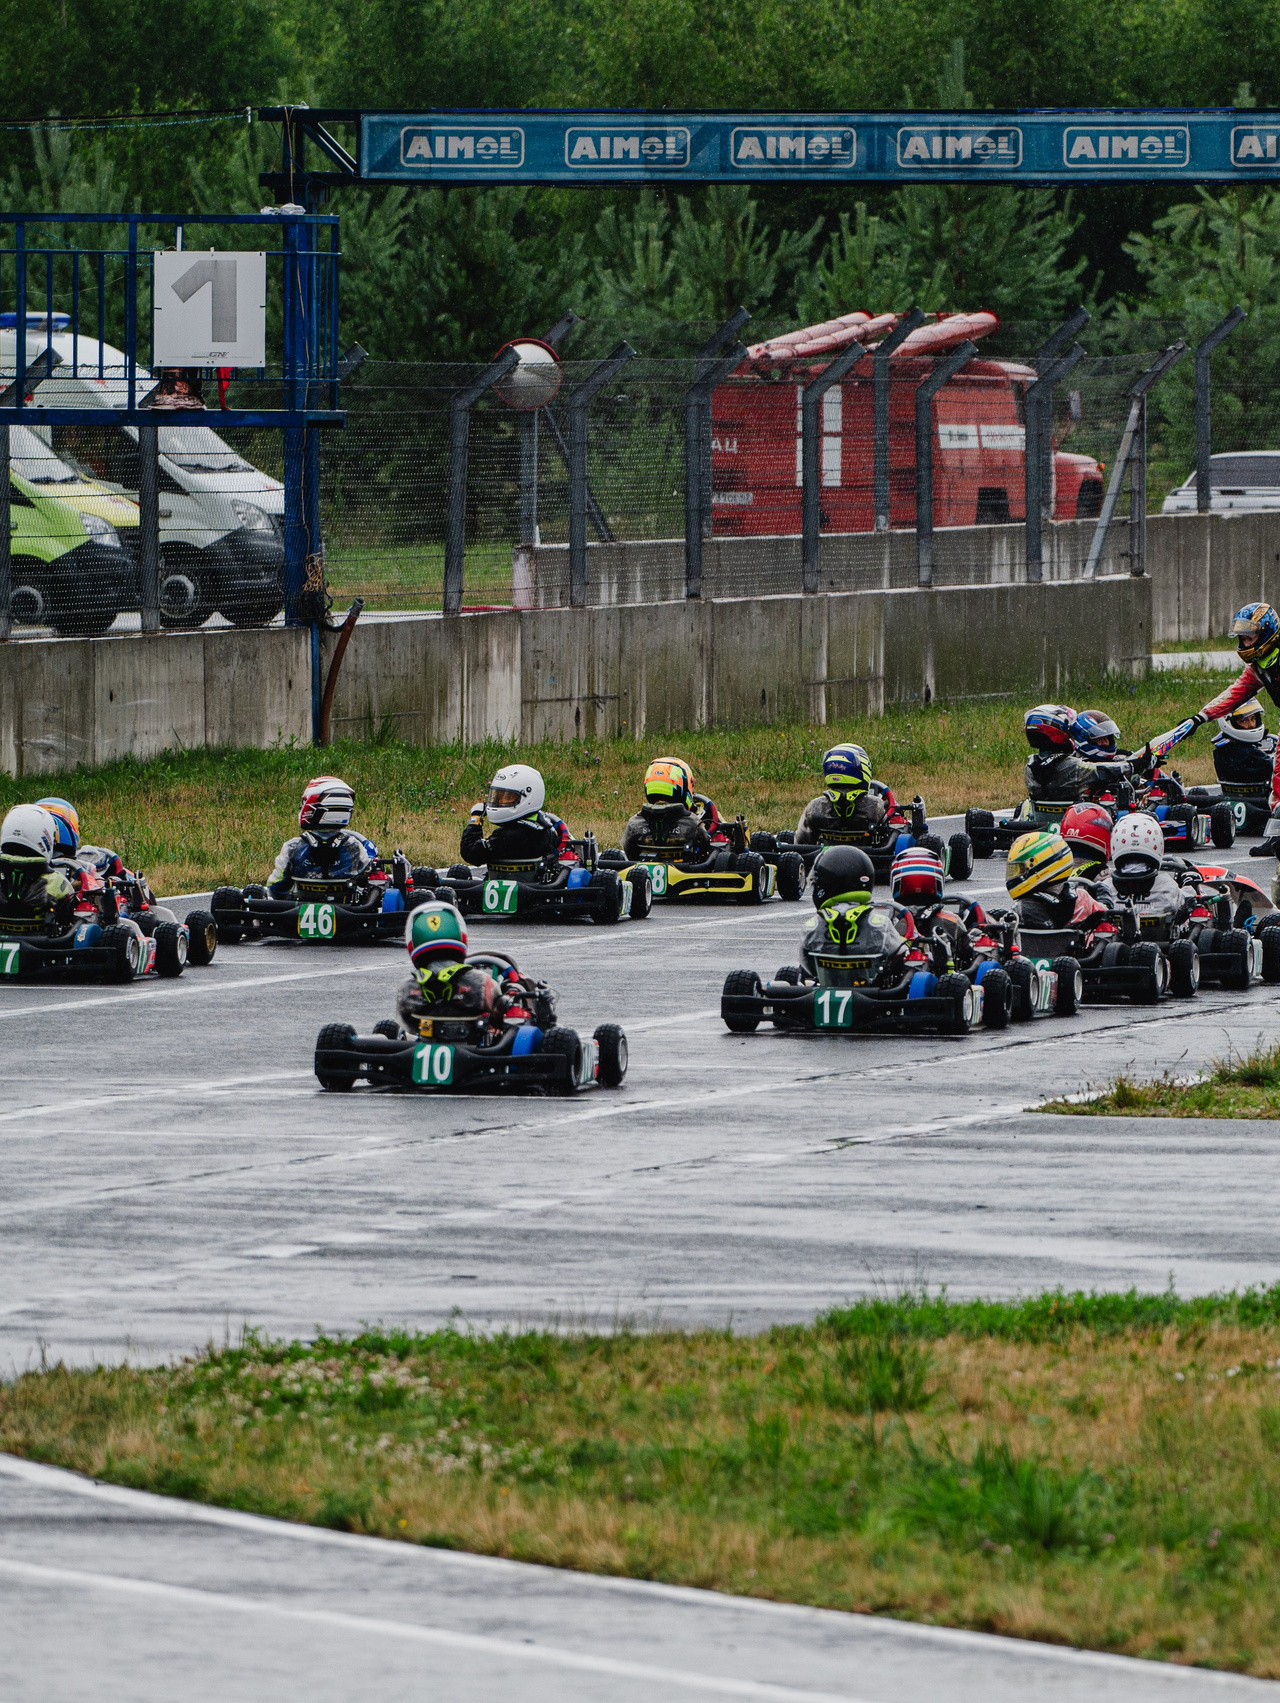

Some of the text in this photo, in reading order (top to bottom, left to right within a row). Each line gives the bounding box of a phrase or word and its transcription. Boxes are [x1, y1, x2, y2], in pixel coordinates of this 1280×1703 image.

[407, 137, 517, 158] AIMOL
[571, 137, 683, 158] AIMOL
[737, 136, 849, 158] AIMOL
[904, 136, 1015, 158] AIMOL
[1070, 136, 1183, 158] AIMOL
[170, 260, 237, 342] 1
[1227, 802, 1246, 826] 9
[485, 880, 517, 910] 67
[300, 904, 332, 935] 46
[0, 943, 20, 973] 7
[818, 958, 869, 969] TILLETT
[817, 990, 852, 1024] 17
[416, 1046, 451, 1081] 10
